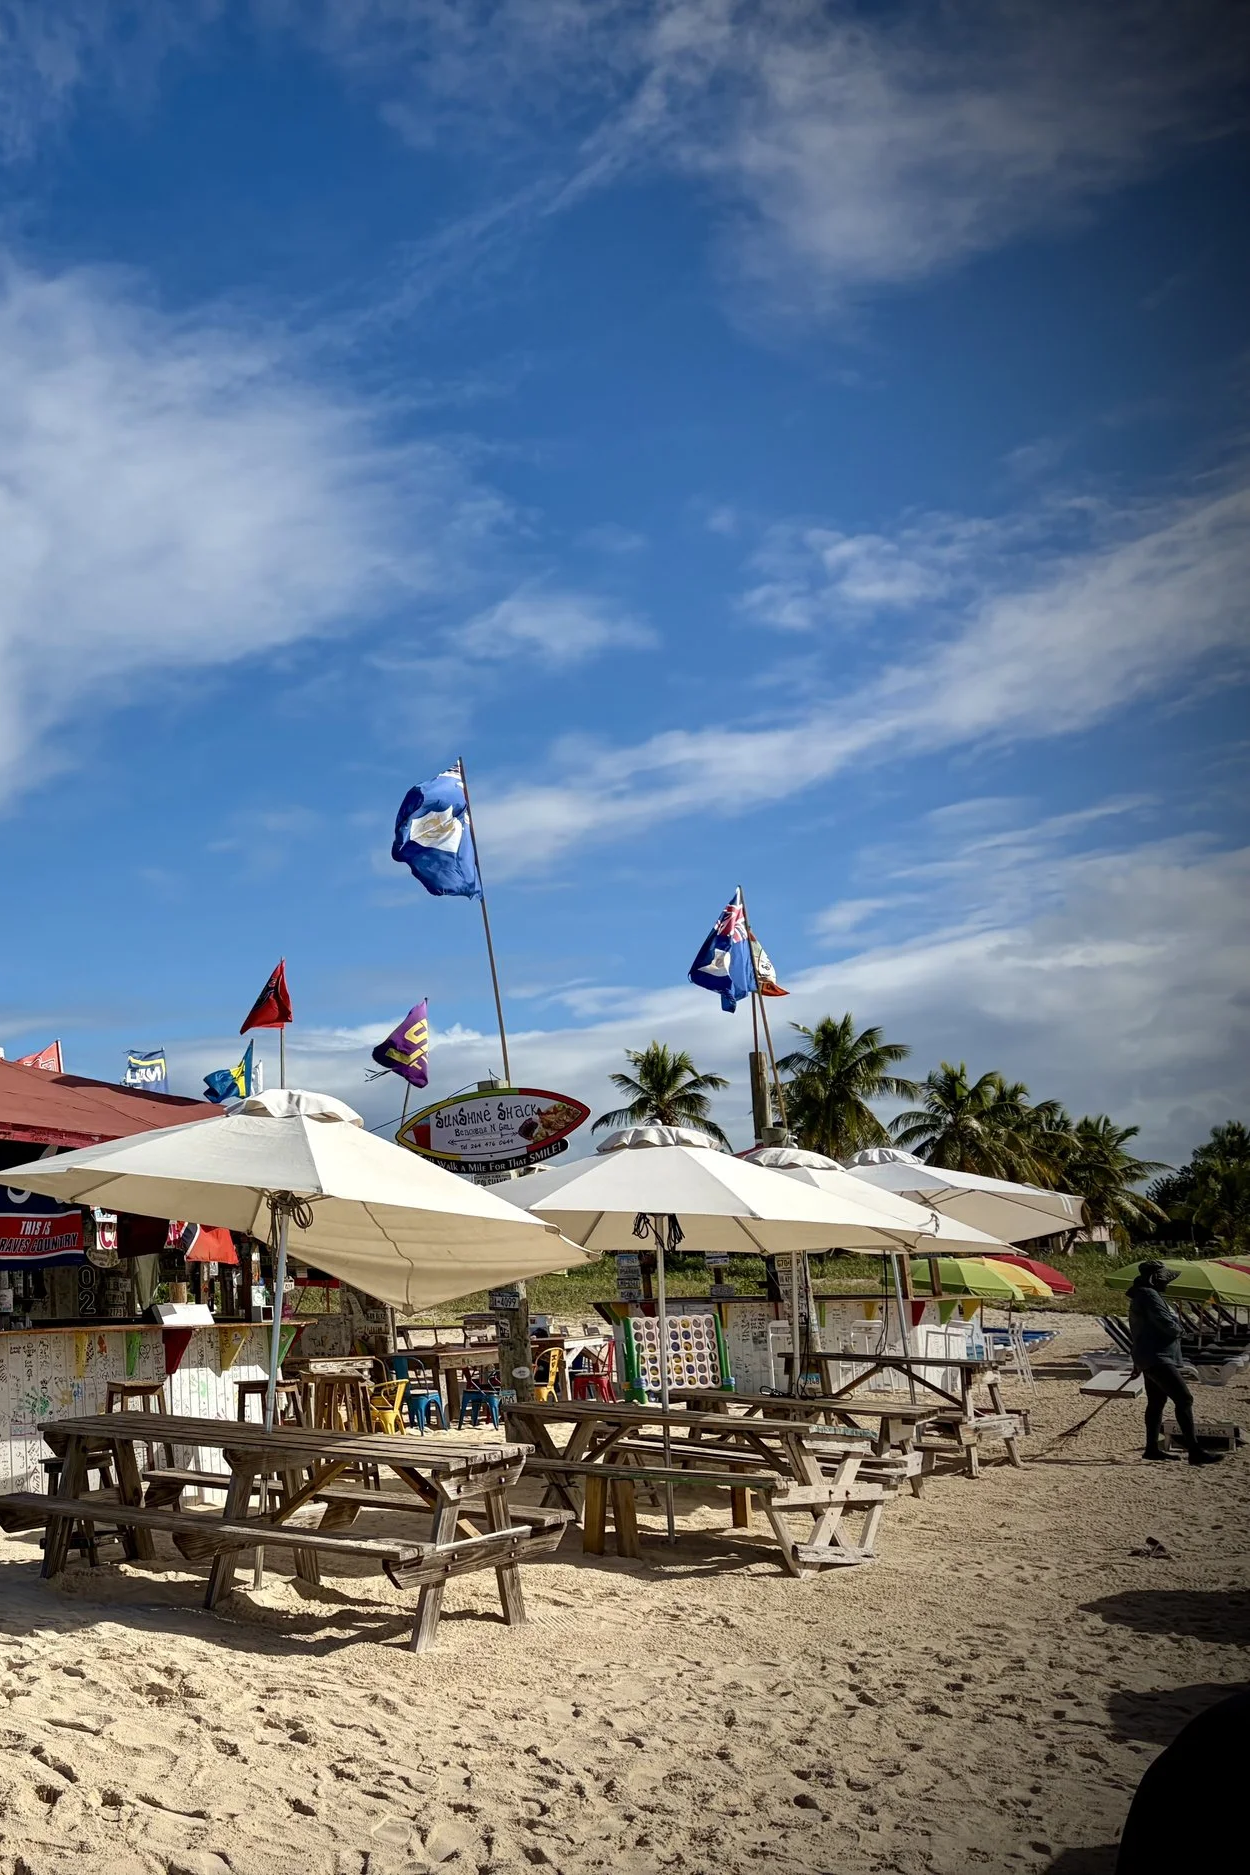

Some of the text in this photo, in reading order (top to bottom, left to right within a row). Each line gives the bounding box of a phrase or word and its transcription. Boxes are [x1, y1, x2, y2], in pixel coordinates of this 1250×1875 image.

[529, 1143, 562, 1163] SMILE!
[20, 1221, 52, 1235] THIS IS
[31, 1232, 79, 1253] COUNTRY
